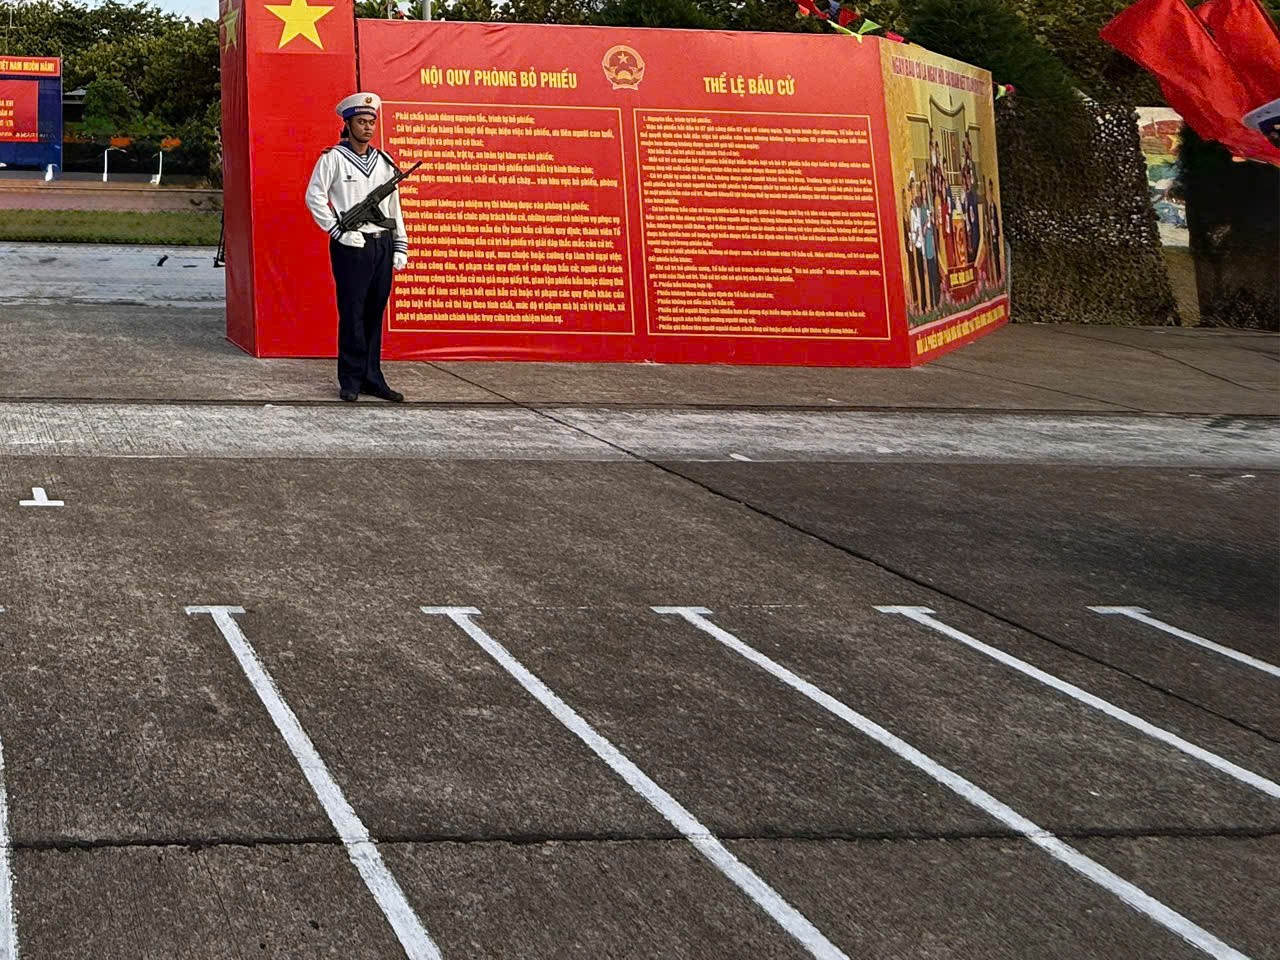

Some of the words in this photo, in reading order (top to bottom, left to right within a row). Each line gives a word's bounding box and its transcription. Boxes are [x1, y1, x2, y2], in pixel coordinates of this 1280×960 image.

[421, 65, 442, 87] NỘI
[446, 69, 470, 86] QUY
[474, 67, 516, 86] PHÒNG
[520, 67, 536, 87] BỎ
[540, 68, 576, 88] PHIẾU
[703, 72, 727, 93] THỂ
[730, 75, 745, 96] LỆ
[748, 73, 773, 94] BẦU
[777, 75, 794, 95] CỬ
